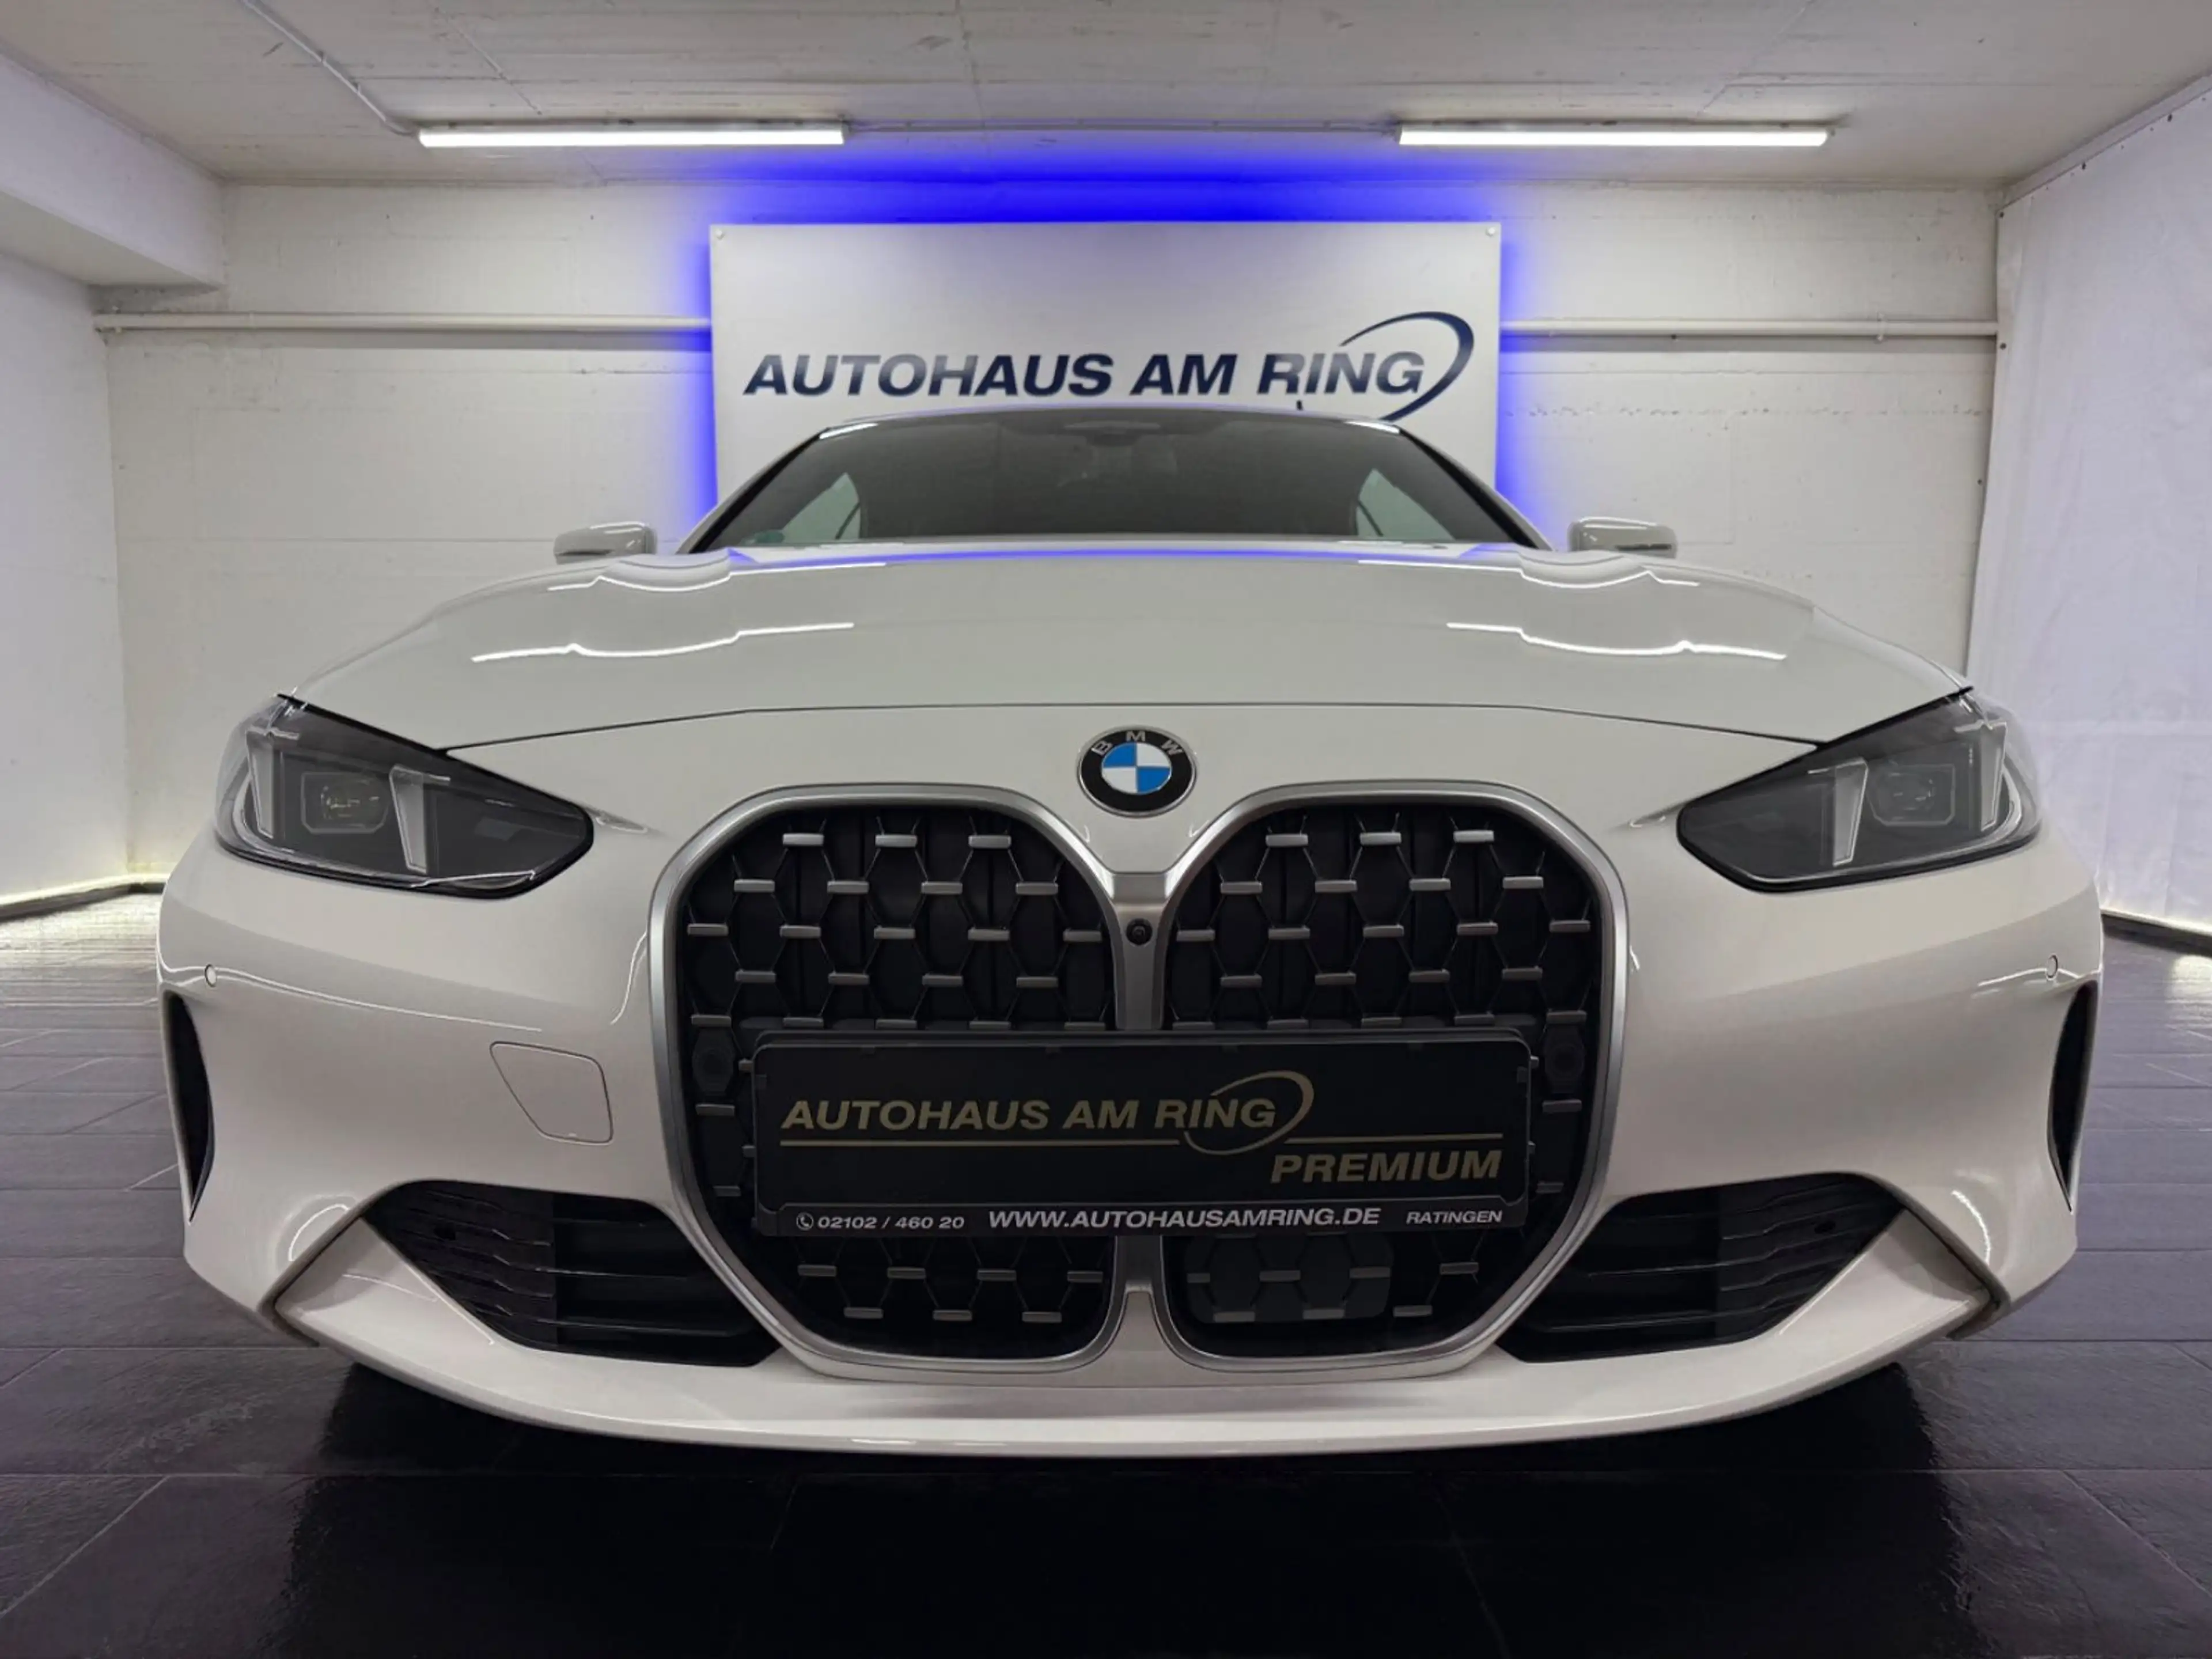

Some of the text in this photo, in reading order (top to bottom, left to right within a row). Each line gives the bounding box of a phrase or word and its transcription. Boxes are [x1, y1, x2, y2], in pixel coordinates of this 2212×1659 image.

[743, 352, 1425, 396] AUTOHAUS AM RING
[1092, 730, 1183, 756] BMW
[782, 1098, 1276, 1130] AUTOHAUS AM RING
[1271, 1150, 1502, 1183] PREMIUM
[817, 1216, 965, 1229] 02102 / 460 20
[989, 1207, 1380, 1229] WWW.AUTOHAUSAMRING.DE
[1406, 1209, 1502, 1225] RATINGEN
